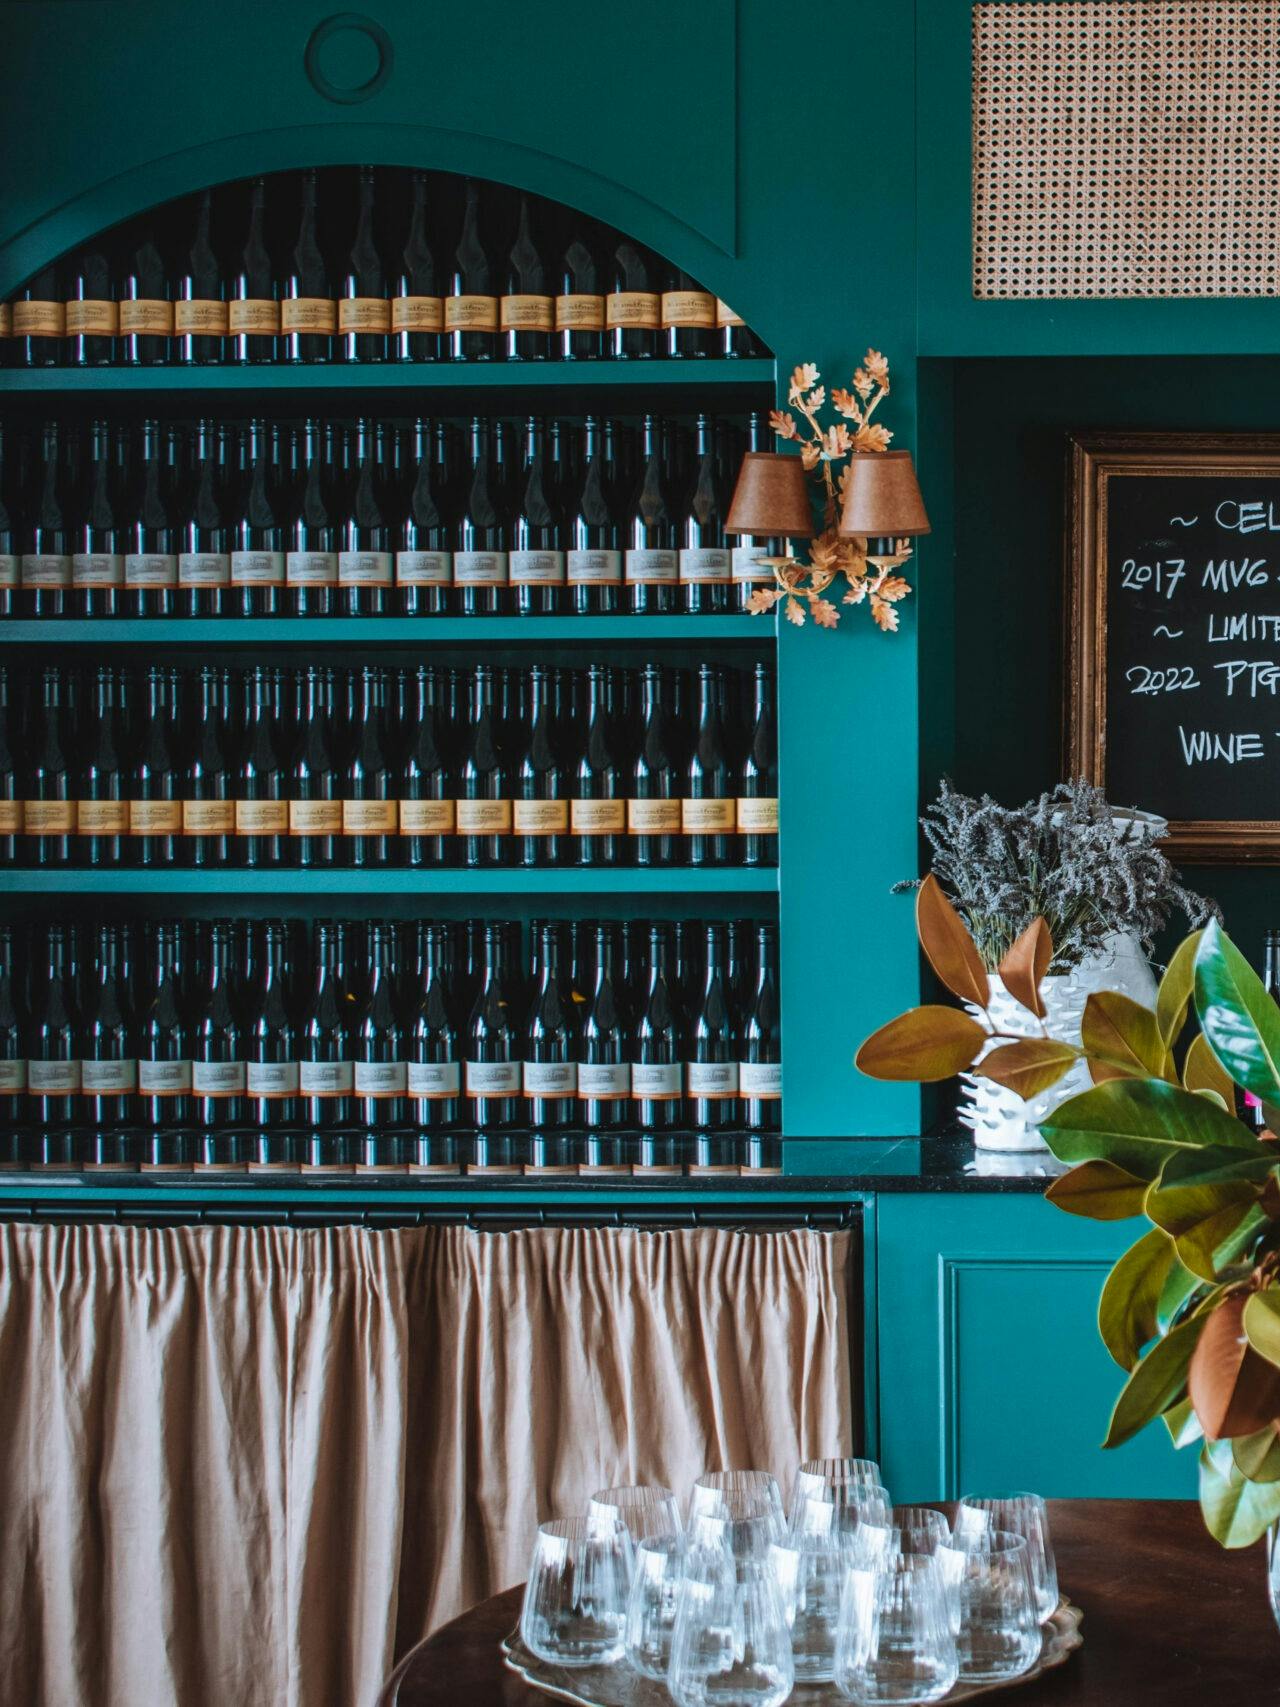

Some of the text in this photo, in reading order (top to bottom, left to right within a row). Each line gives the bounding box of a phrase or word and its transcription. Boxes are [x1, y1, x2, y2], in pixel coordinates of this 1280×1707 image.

[1121, 558, 1186, 600] 2017
[1125, 665, 1201, 696] 2022
[1178, 725, 1265, 766] WINE
